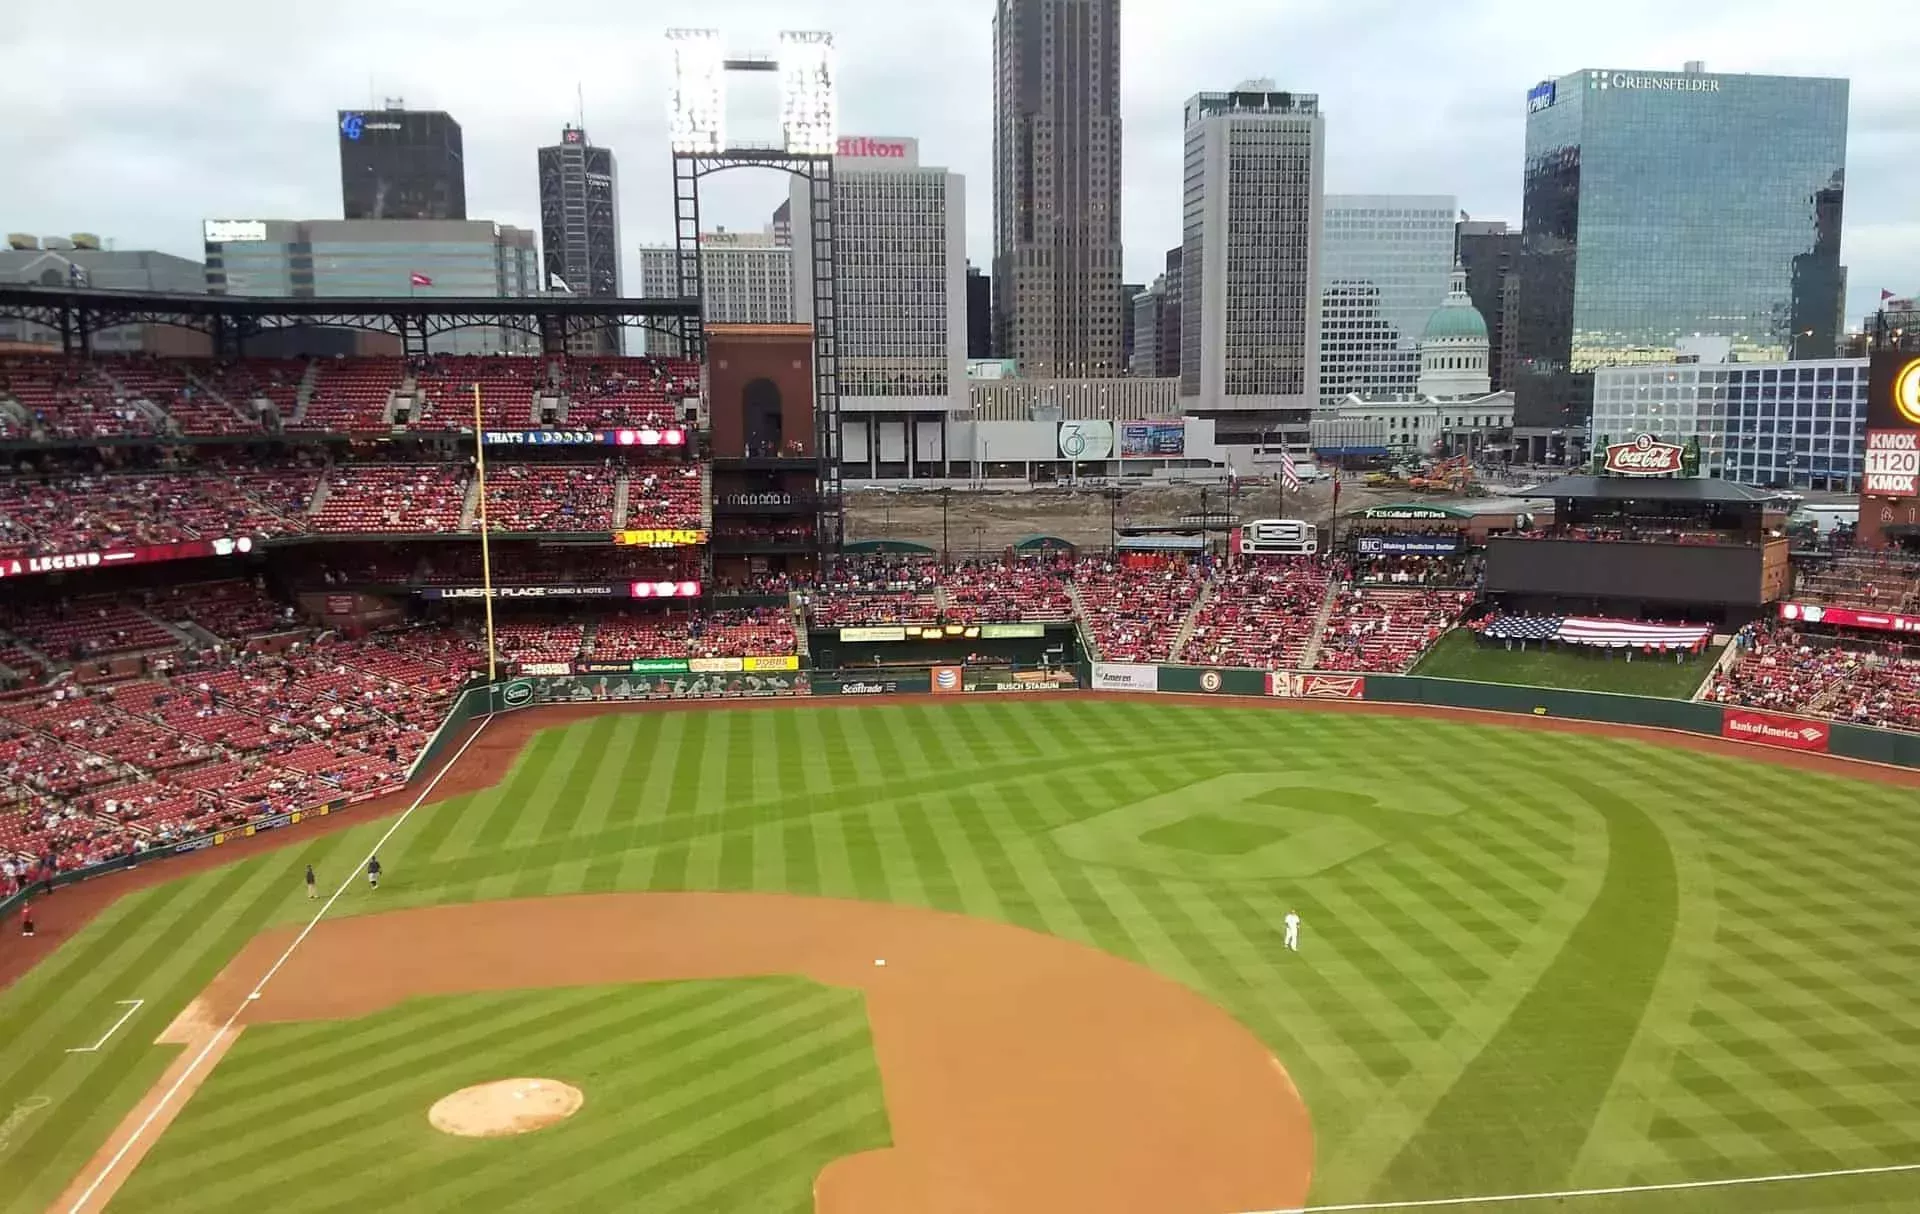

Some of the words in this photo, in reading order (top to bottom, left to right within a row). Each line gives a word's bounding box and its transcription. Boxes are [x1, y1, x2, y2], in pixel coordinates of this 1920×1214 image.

[836, 136, 905, 158] Hilton
[1870, 433, 1917, 450] KMOX
[1870, 453, 1916, 473] 1120
[1867, 476, 1914, 491] KMOX
[1361, 541, 1380, 550] BJC
[11, 560, 22, 573] A
[30, 553, 100, 571] LEGEND
[501, 587, 546, 597] PLACE
[997, 682, 1024, 691] BUSCH
[1024, 681, 1060, 690] STADIUM
[1730, 719, 1753, 731] Bank
[1762, 726, 1799, 739] America
